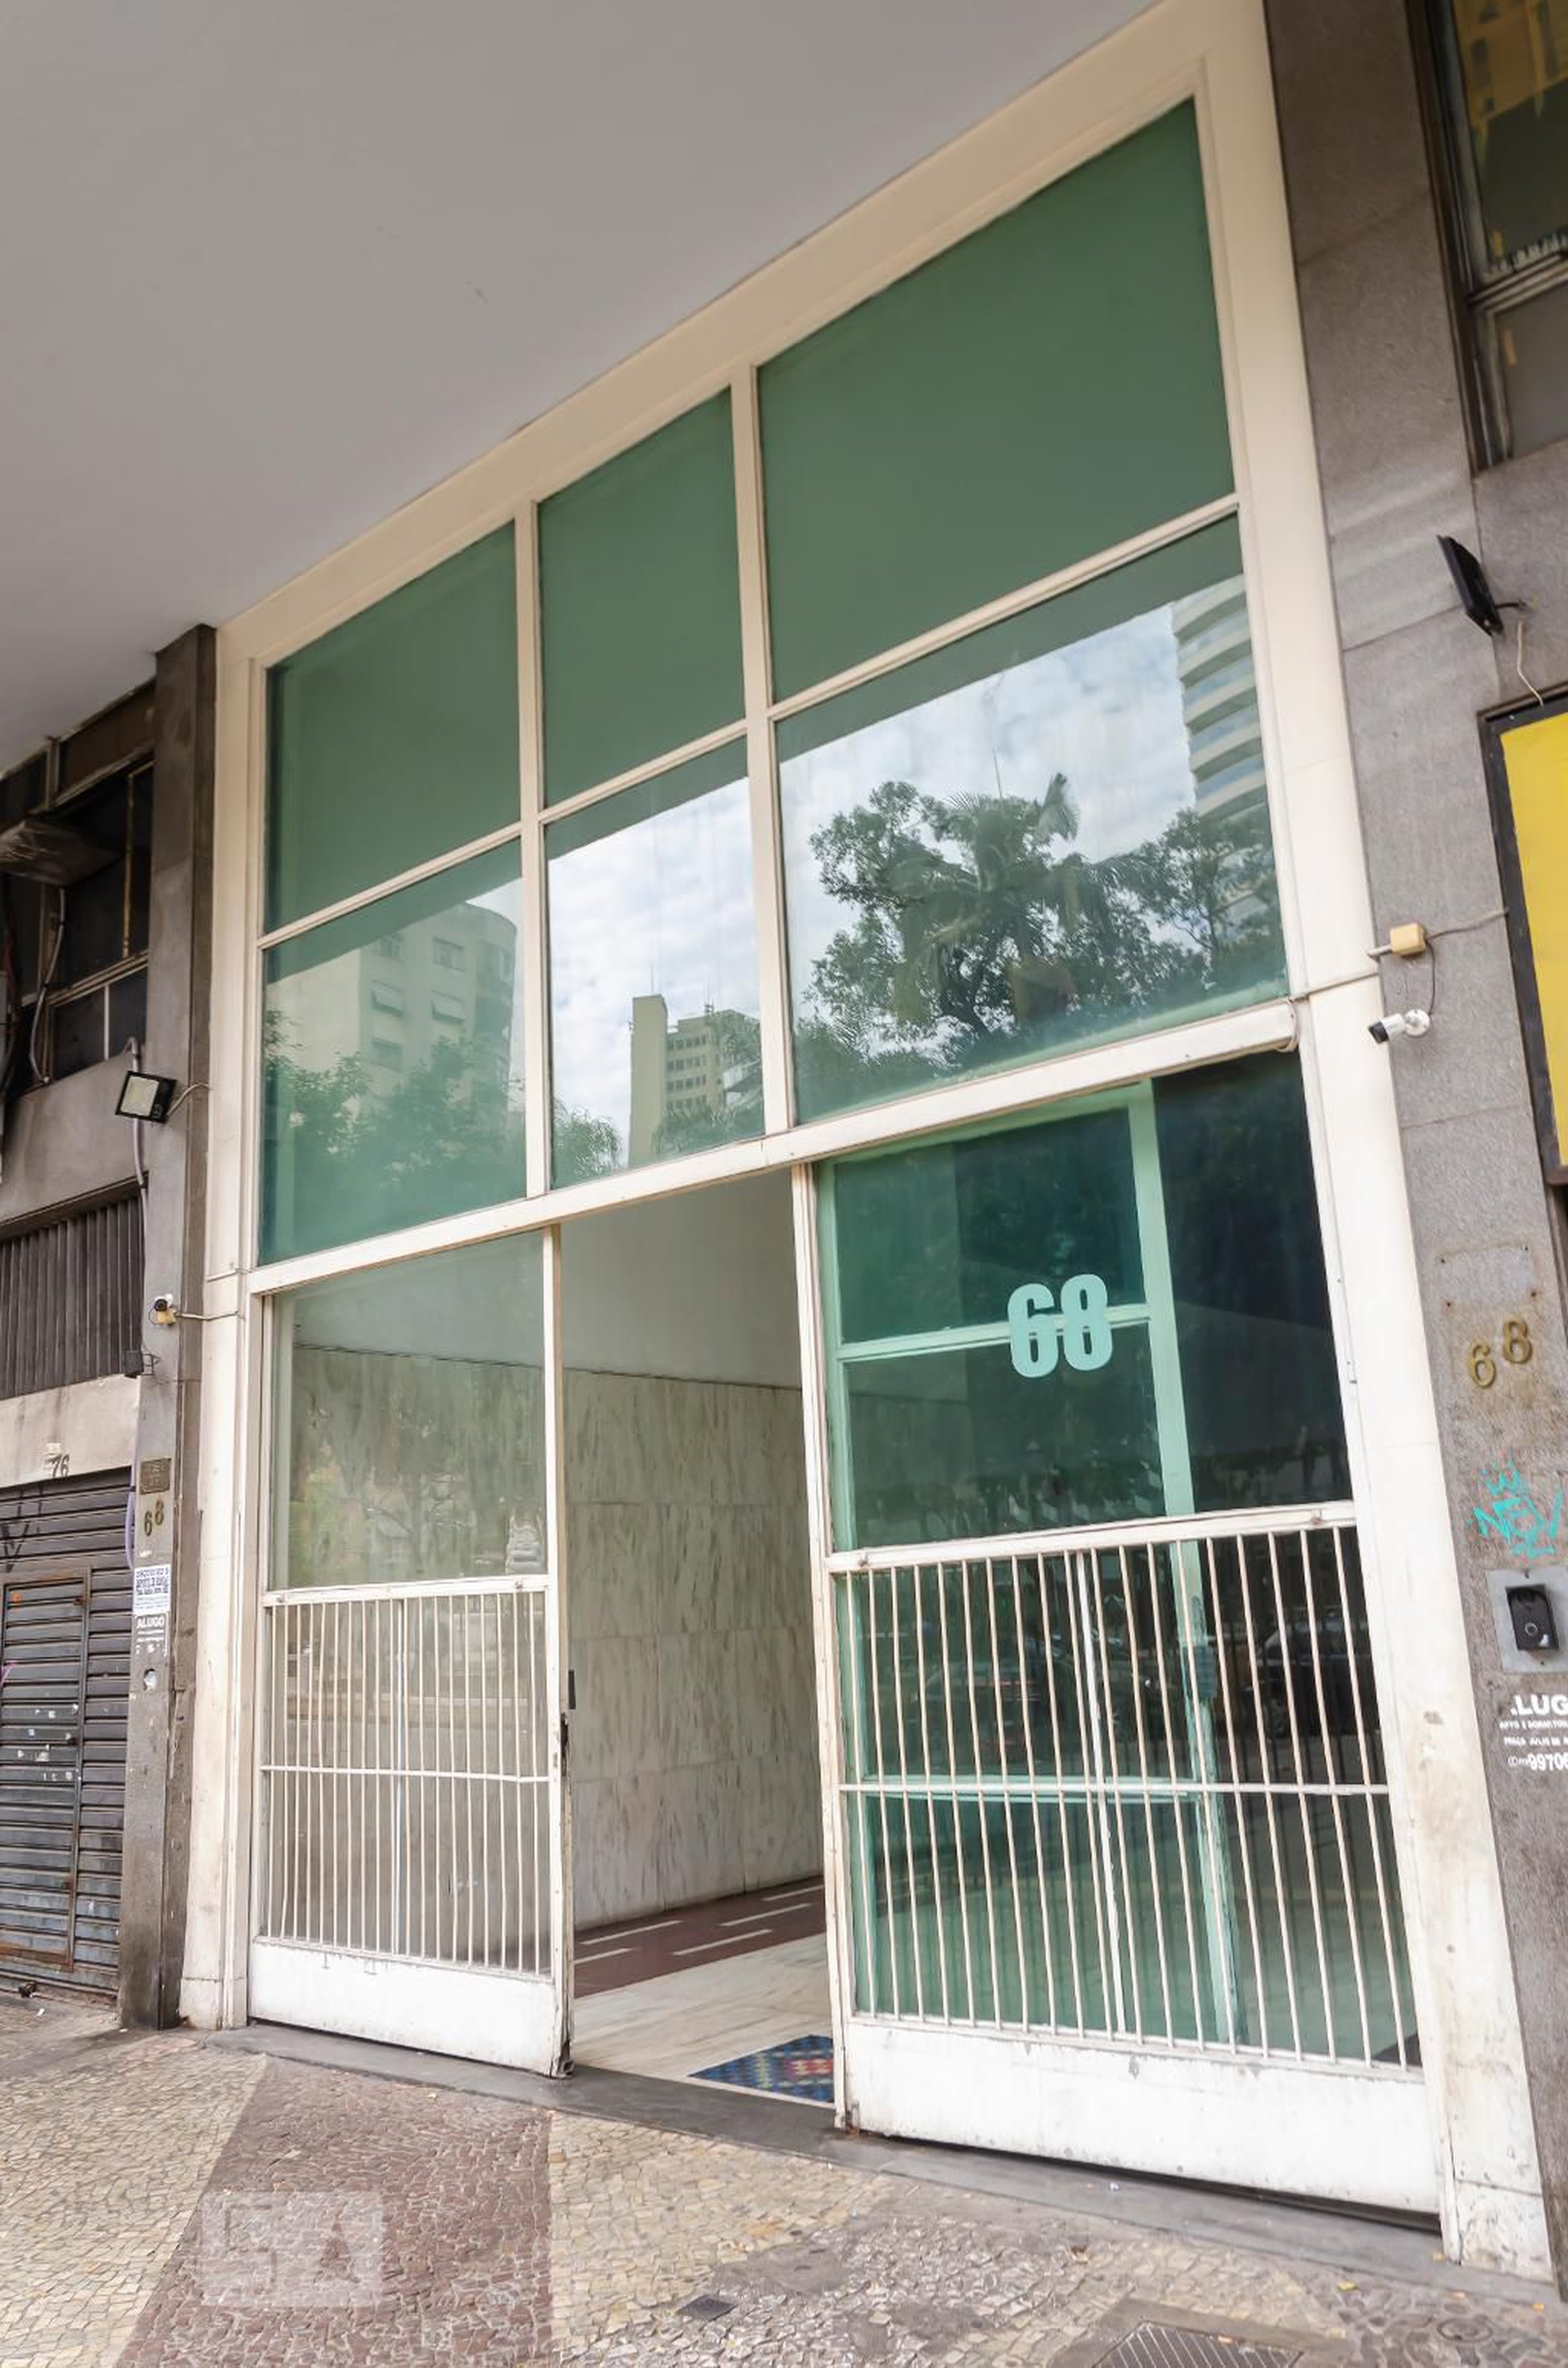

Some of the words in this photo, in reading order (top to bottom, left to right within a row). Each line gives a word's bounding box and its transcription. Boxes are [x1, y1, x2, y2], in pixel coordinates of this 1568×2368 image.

[1007, 1274, 1112, 1378] 68
[1468, 1317, 1533, 1389] 68
[144, 1501, 164, 1536] 68
[136, 1616, 164, 1628] ALUGO
